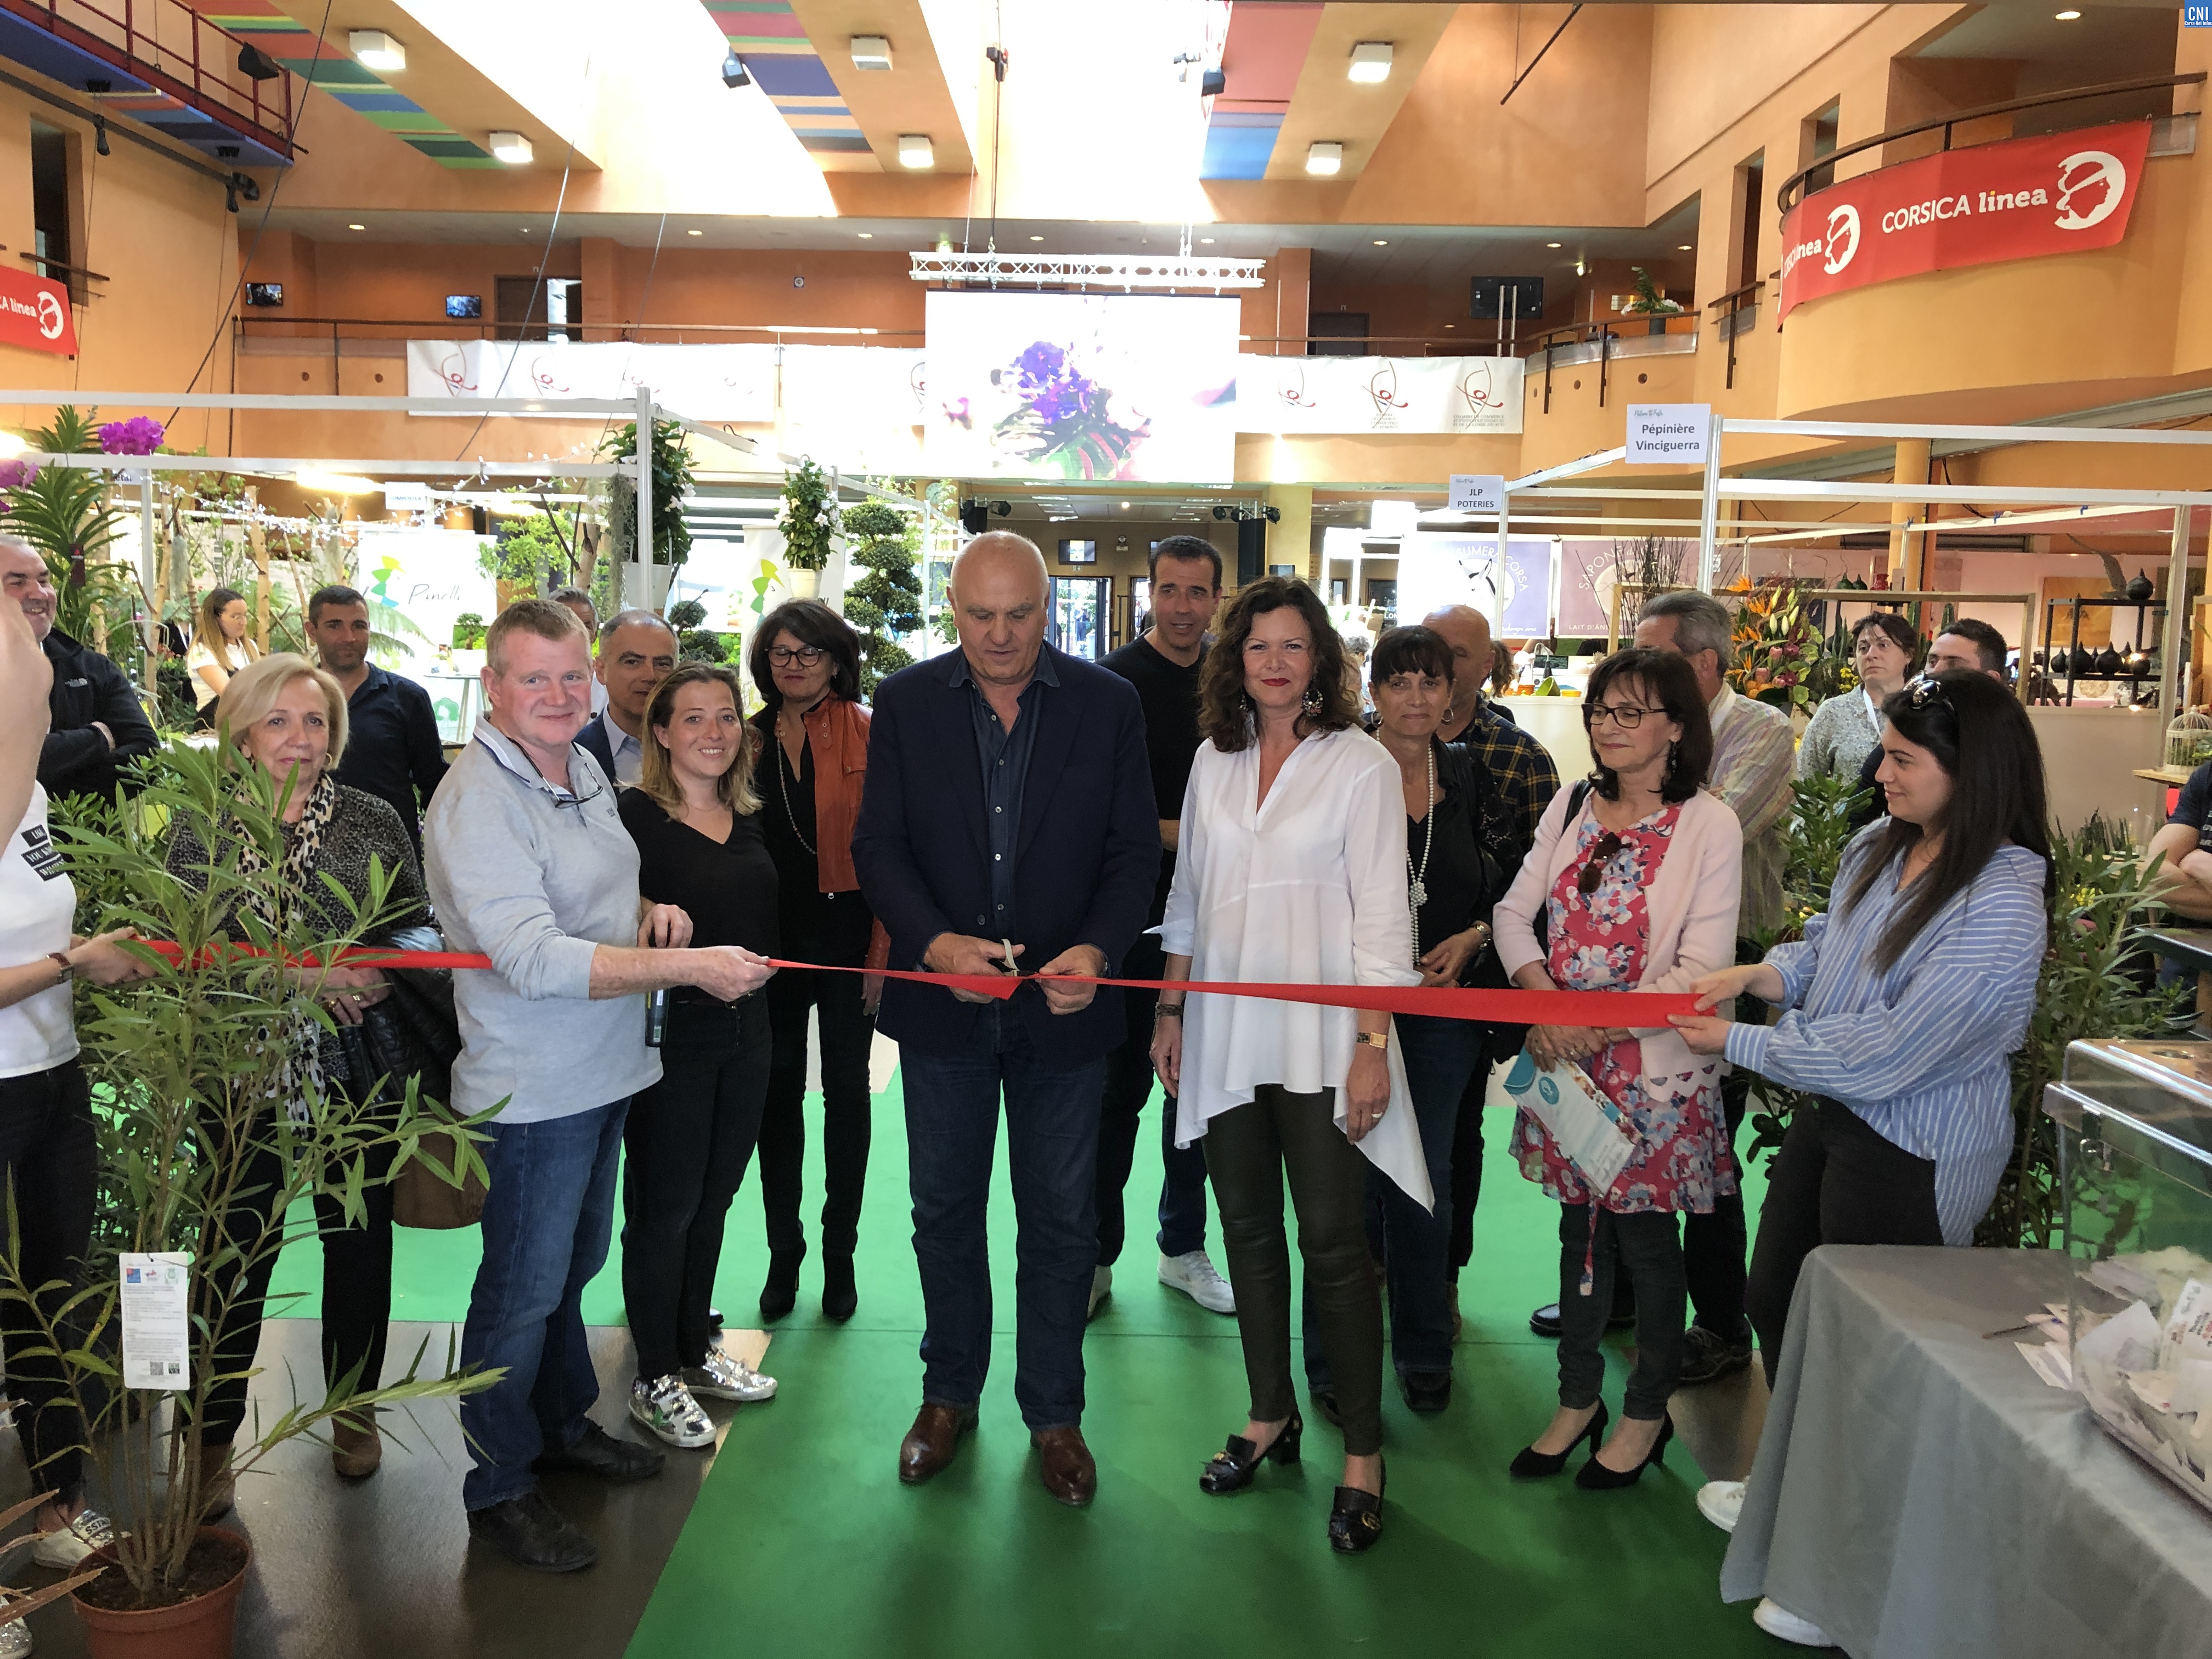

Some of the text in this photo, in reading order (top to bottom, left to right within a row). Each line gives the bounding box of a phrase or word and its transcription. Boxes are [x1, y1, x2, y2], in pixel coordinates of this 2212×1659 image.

[1882, 188, 2048, 233] CORSICA linea
[9, 297, 37, 317] linea
[1642, 423, 1695, 436] Pépinière
[1636, 440, 1700, 452] Vinciguerra
[1578, 545, 1622, 590] SAPONE
